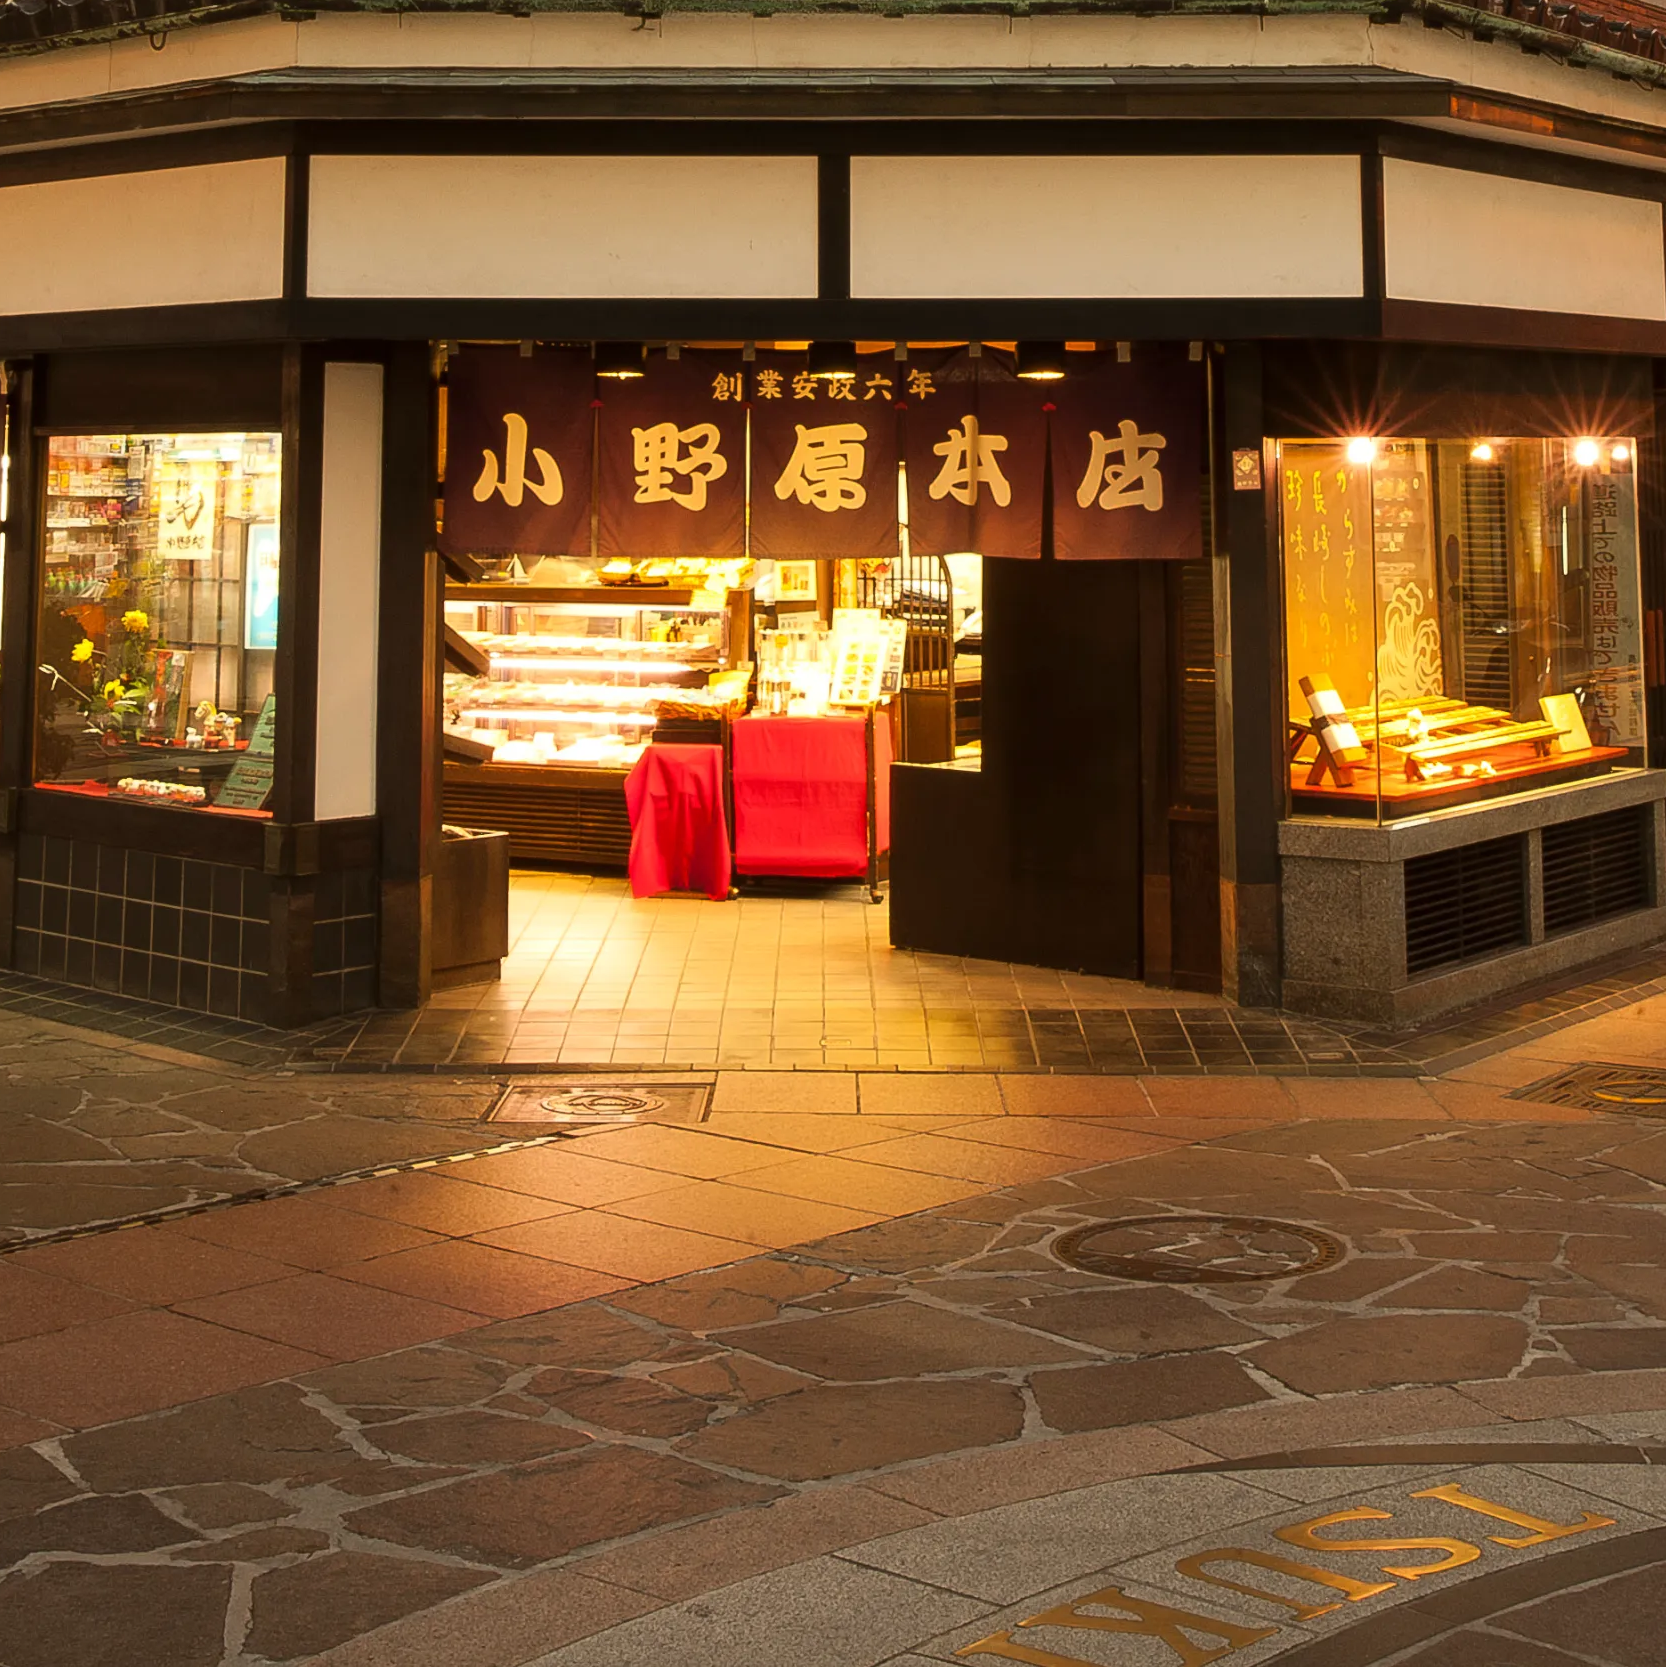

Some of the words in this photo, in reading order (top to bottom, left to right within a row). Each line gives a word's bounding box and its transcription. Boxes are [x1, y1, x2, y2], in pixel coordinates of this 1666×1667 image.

[711, 368, 938, 402] 創業安政六年
[472, 413, 1168, 514] 小野原本店
